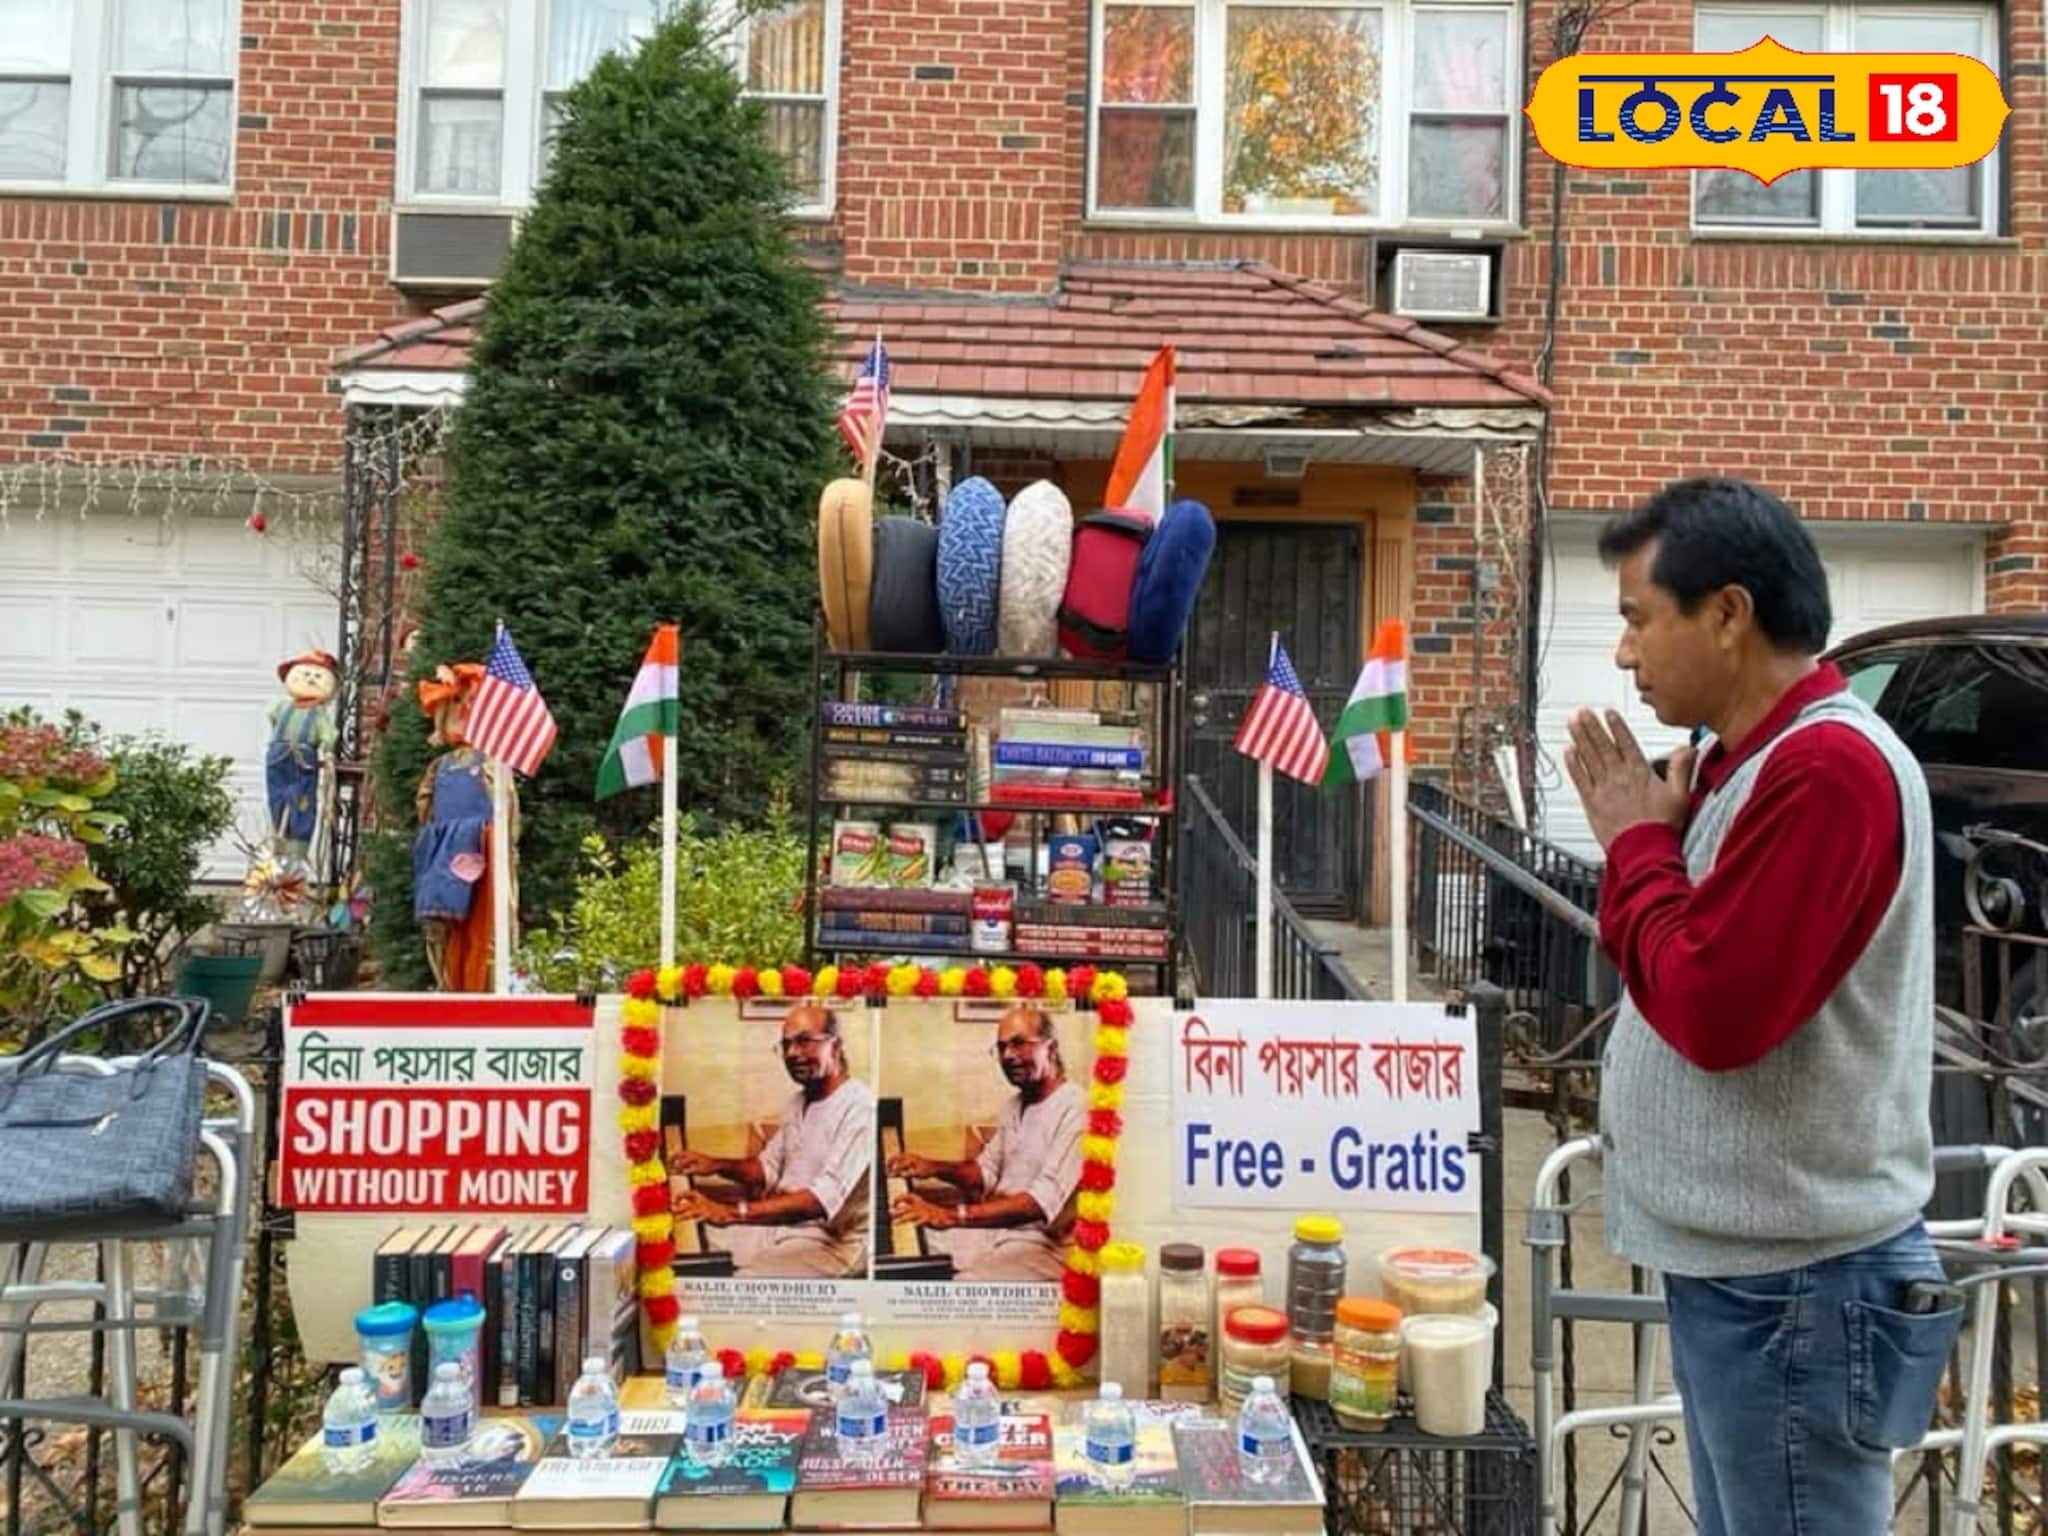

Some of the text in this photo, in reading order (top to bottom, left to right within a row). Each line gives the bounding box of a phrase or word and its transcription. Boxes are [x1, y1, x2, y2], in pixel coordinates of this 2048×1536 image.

[298, 1030, 583, 1084] বিনা পয়সার বাজার
[1182, 1016, 1465, 1100] বিনা পয়সার বাজার
[293, 1098, 581, 1156] SHOPPING
[1186, 1124, 1283, 1188] Free
[1330, 1126, 1466, 1192] Gratis
[292, 1167, 578, 1206] WITHOUT MONEY
[684, 1281, 838, 1296] SALIL CHOWDHURY
[904, 1286, 949, 1298] SALIL
